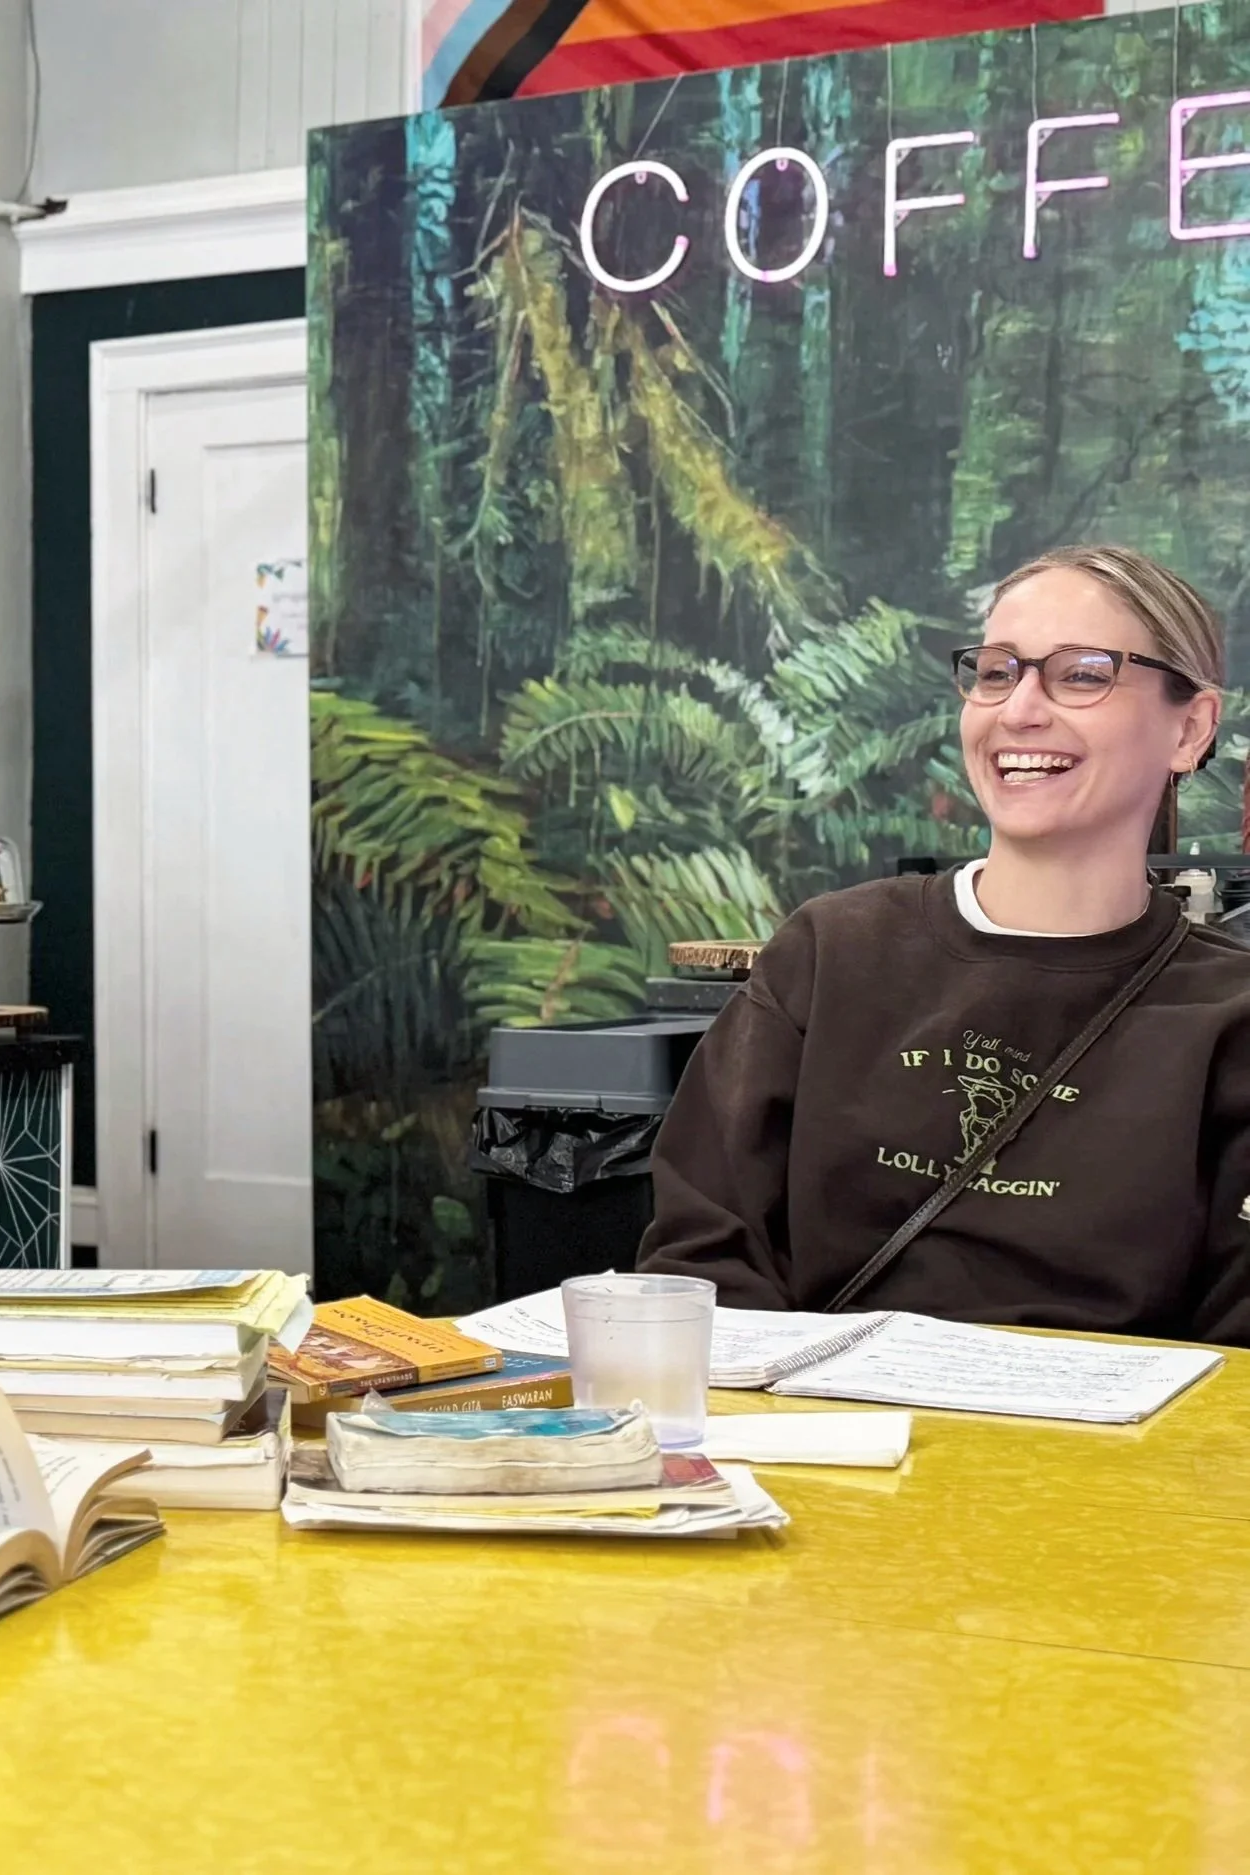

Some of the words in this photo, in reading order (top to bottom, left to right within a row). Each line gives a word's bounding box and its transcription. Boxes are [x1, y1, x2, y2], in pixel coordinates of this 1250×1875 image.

[579, 90, 1250, 292] COFFE
[900, 1050, 931, 1067] IF
[943, 1049, 953, 1066] I
[965, 1052, 1001, 1074] DO
[963, 1029, 1002, 1050] Y'all
[1004, 1046, 1033, 1063] mind
[877, 1147, 1061, 1197] LOLLYAGGIN'
[501, 1388, 553, 1409] EASWARAN
